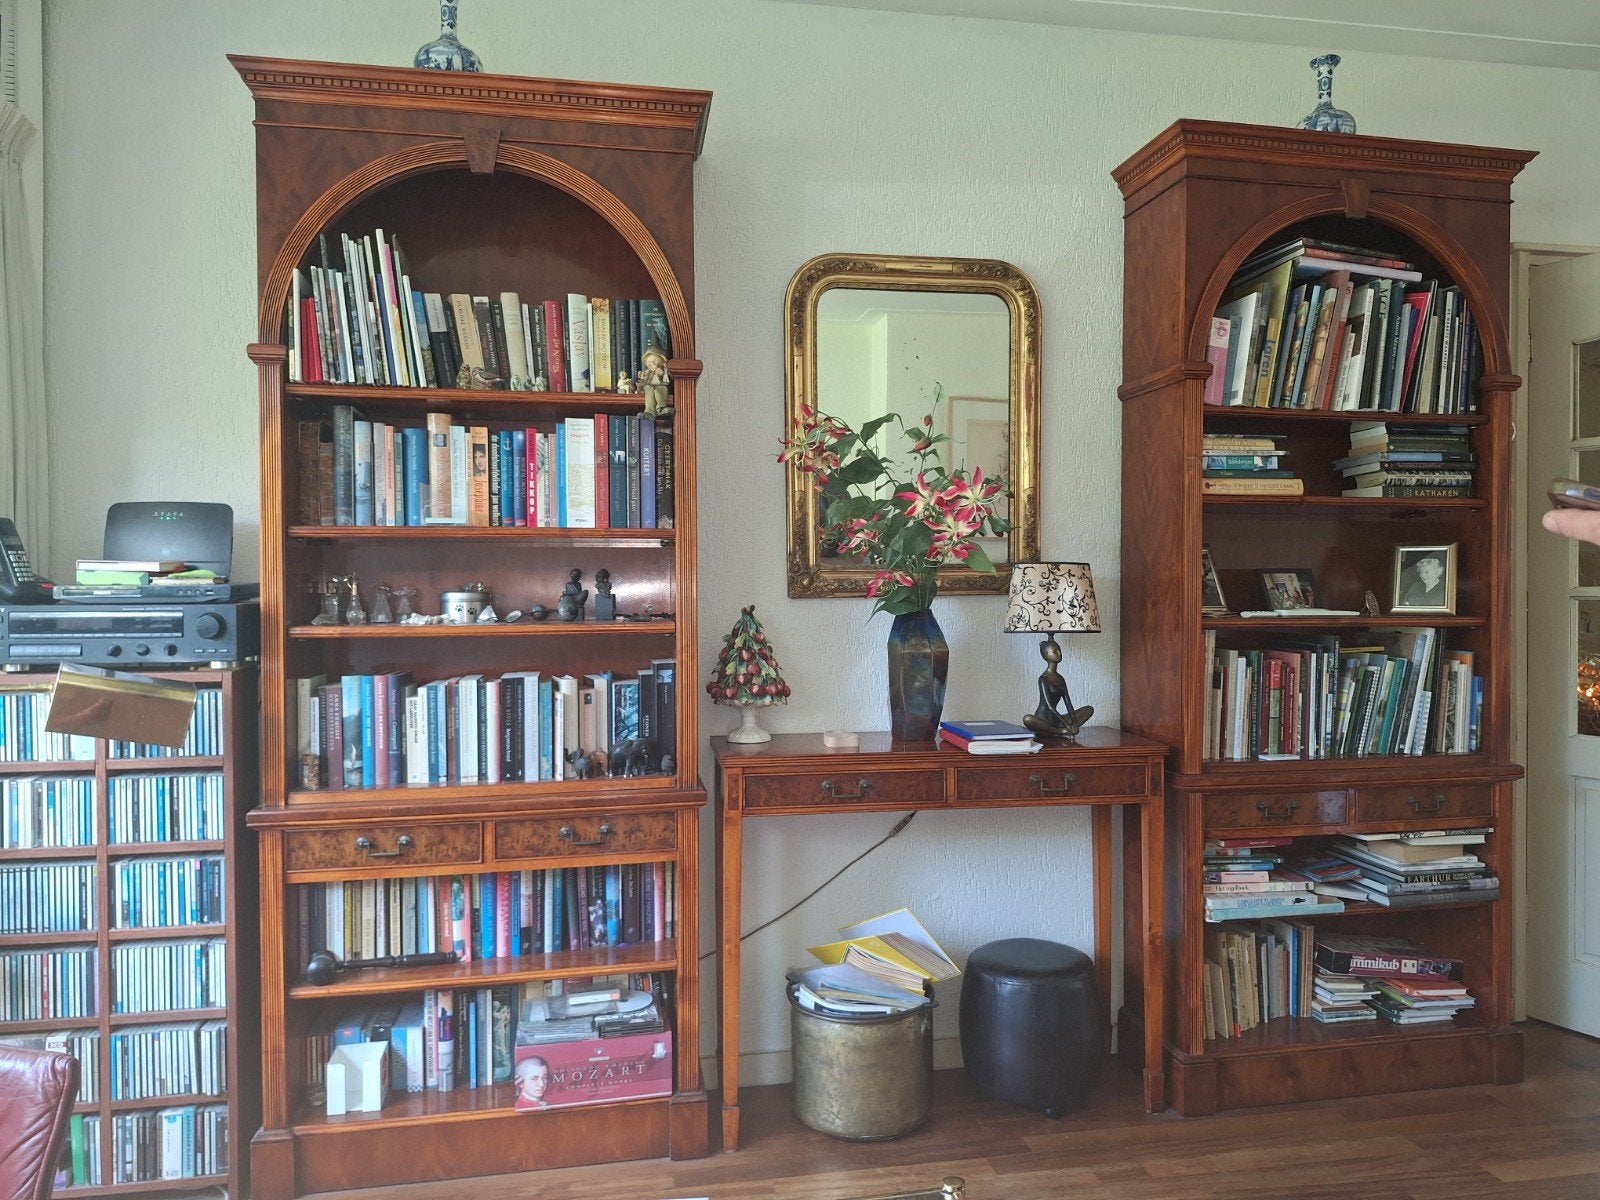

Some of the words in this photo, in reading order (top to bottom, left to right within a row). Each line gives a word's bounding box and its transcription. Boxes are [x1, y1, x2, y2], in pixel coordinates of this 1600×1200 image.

[1394, 315, 1402, 335] Anton
[553, 338, 560, 347] De
[572, 320, 587, 359] Vaslav
[1361, 325, 1369, 356] MONDRIAAN
[551, 350, 561, 373] Koning
[1261, 339, 1276, 378] Laren
[657, 438, 663, 447] De
[491, 443, 500, 494] doodshoofdvlinder
[474, 480, 487, 513] Josephine
[490, 495, 500, 504] jan
[1414, 489, 1459, 498] KATHAREN
[491, 505, 500, 526] wolkers
[1413, 874, 1451, 884] ARTHUR
[552, 1064, 647, 1085] MOZART
[566, 1082, 603, 1090] COMPLETE
